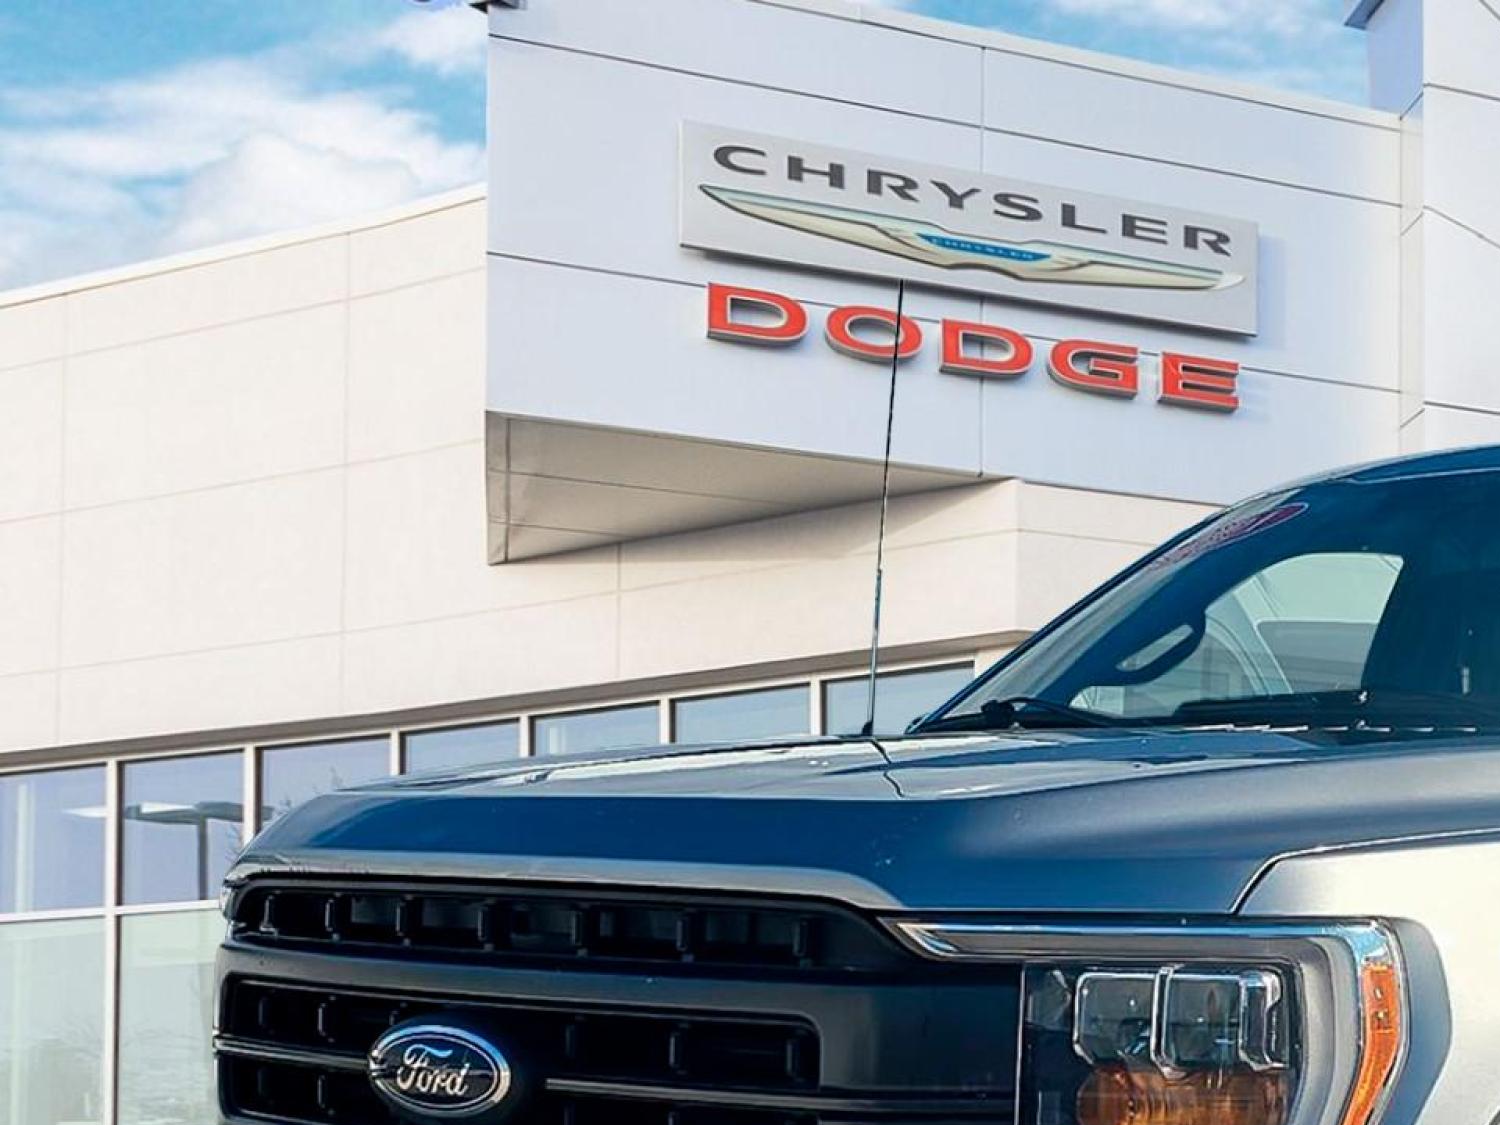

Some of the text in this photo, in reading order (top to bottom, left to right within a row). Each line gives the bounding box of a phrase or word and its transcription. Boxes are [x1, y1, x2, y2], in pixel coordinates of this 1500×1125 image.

[712, 144, 1232, 257] CHRYSLER
[706, 282, 1241, 413] DODGE
[396, 1043, 471, 1096] Ford
